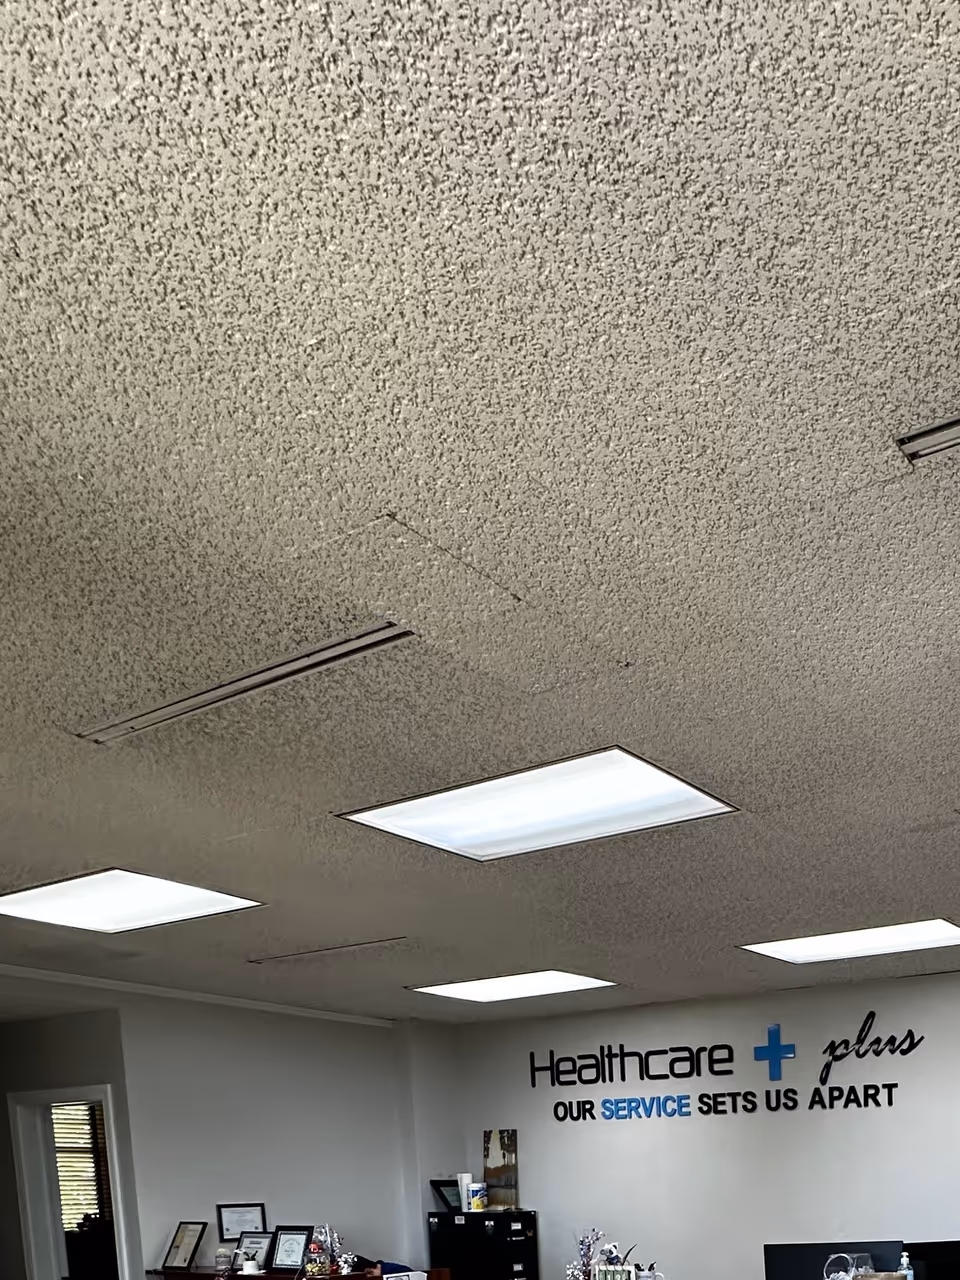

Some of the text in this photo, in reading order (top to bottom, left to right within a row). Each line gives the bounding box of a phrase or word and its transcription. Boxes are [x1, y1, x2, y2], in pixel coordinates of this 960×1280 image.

[529, 1010, 925, 1088] Healthcare plus
[553, 1082, 899, 1122] OUR SERVICE SETS US APART
